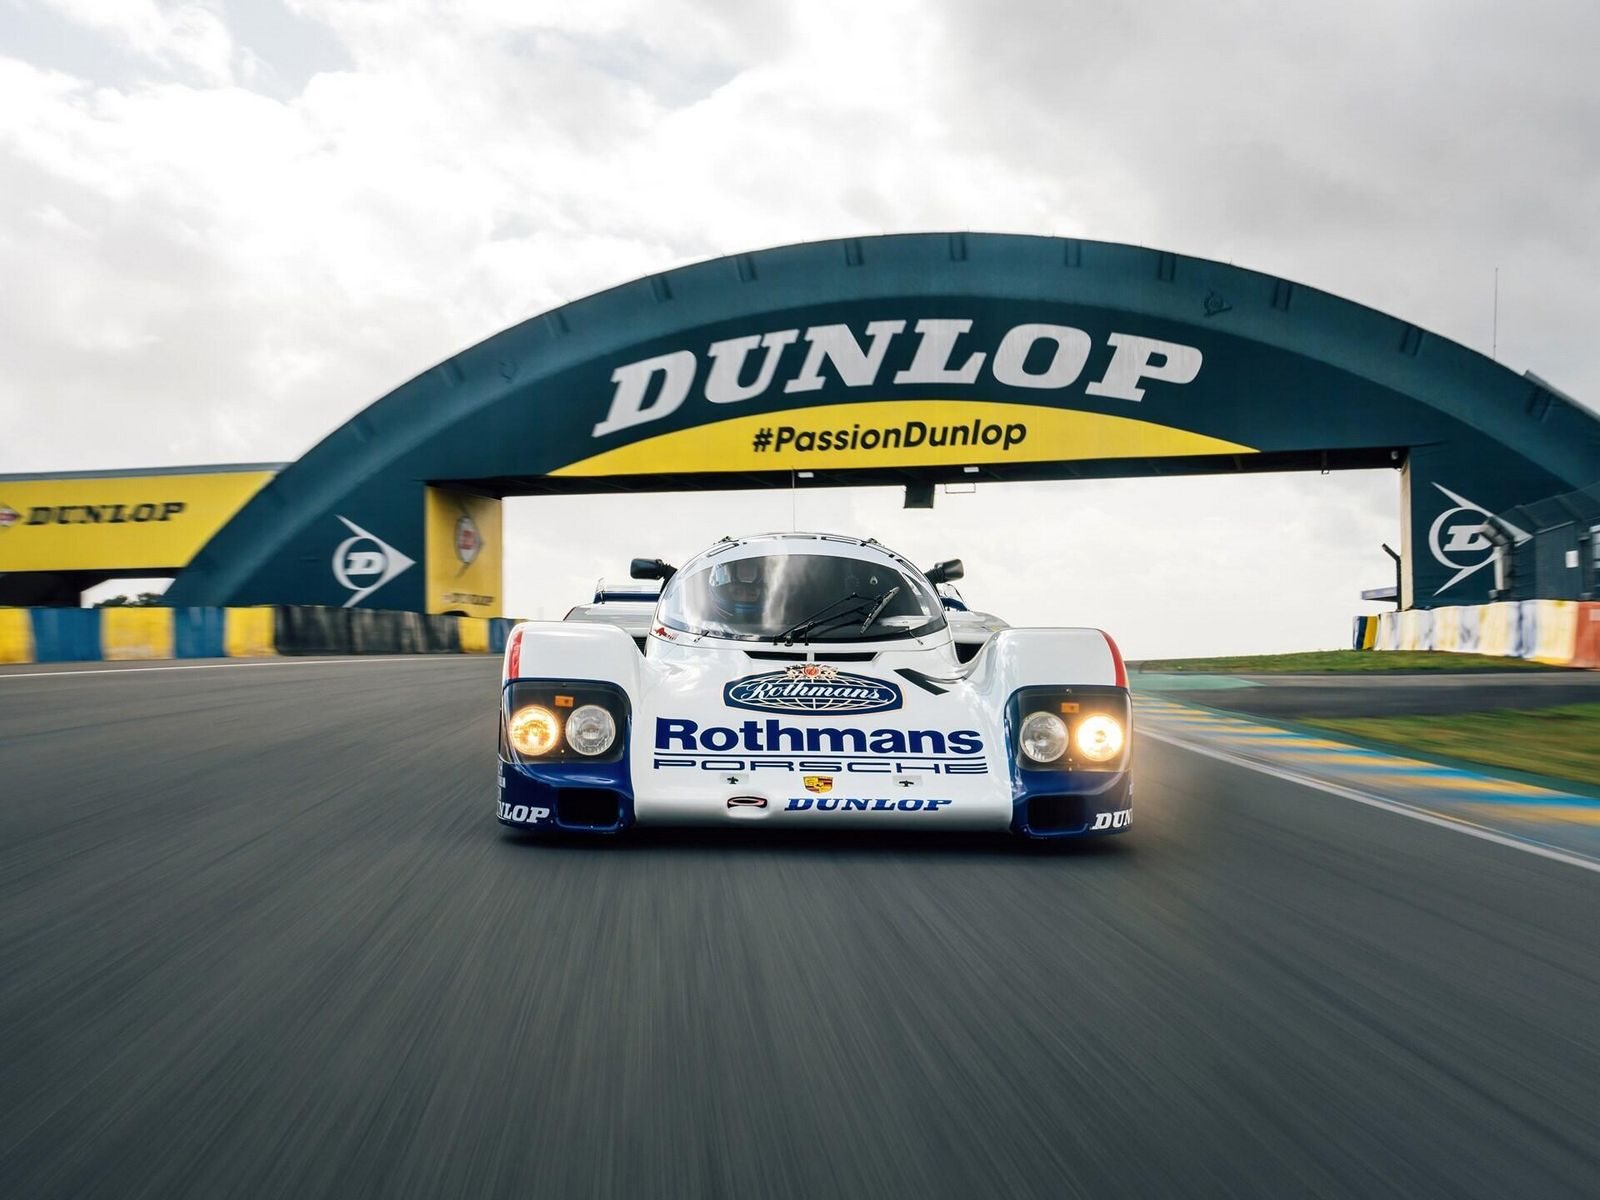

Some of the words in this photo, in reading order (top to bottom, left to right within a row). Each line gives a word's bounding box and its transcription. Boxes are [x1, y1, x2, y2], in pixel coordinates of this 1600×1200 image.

[592, 318, 1203, 437] DUNLOP
[753, 419, 1028, 452] #PassionDunlop
[25, 502, 187, 525] DUNLOP
[741, 681, 888, 703] Rothmans
[655, 717, 984, 754] Rothmans
[653, 758, 988, 775] PORSCHE
[784, 798, 952, 812] DUNLOP
